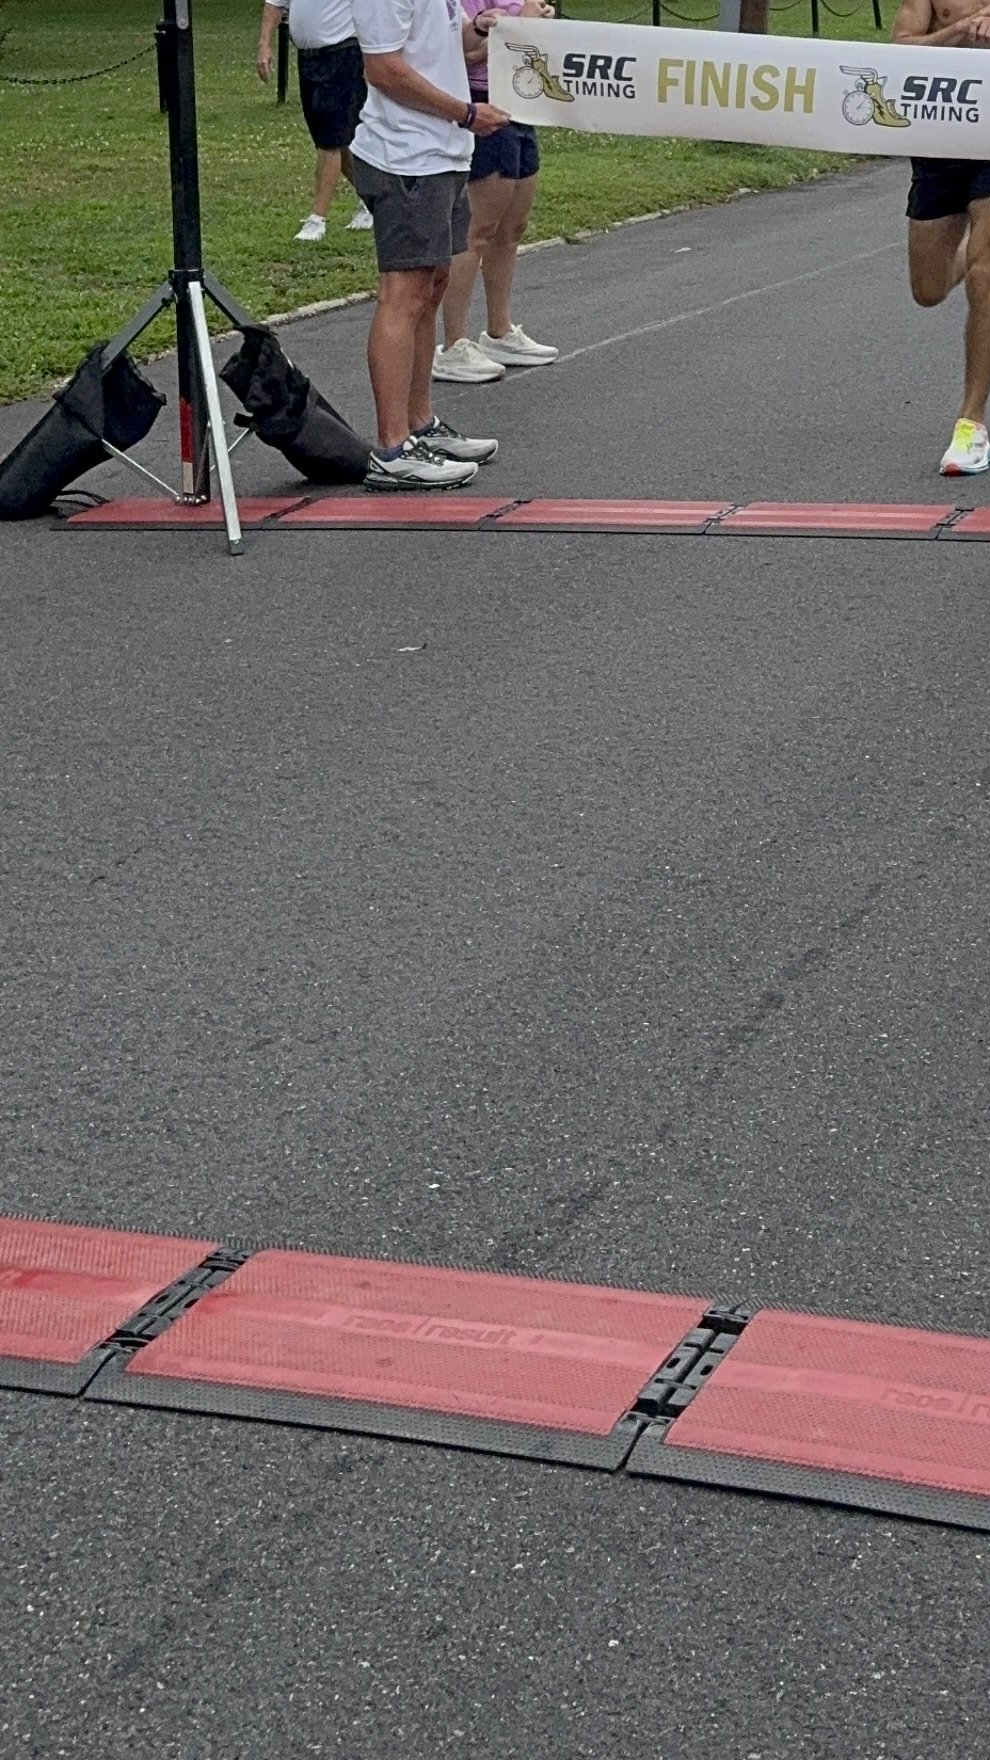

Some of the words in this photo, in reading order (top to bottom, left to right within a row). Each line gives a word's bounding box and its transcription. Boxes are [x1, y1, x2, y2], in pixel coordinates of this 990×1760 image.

[562, 53, 637, 81] SRC
[562, 79, 636, 99] TIMING
[656, 57, 817, 114] FINISH
[900, 75, 983, 104] SRC
[900, 103, 980, 123] TIMING
